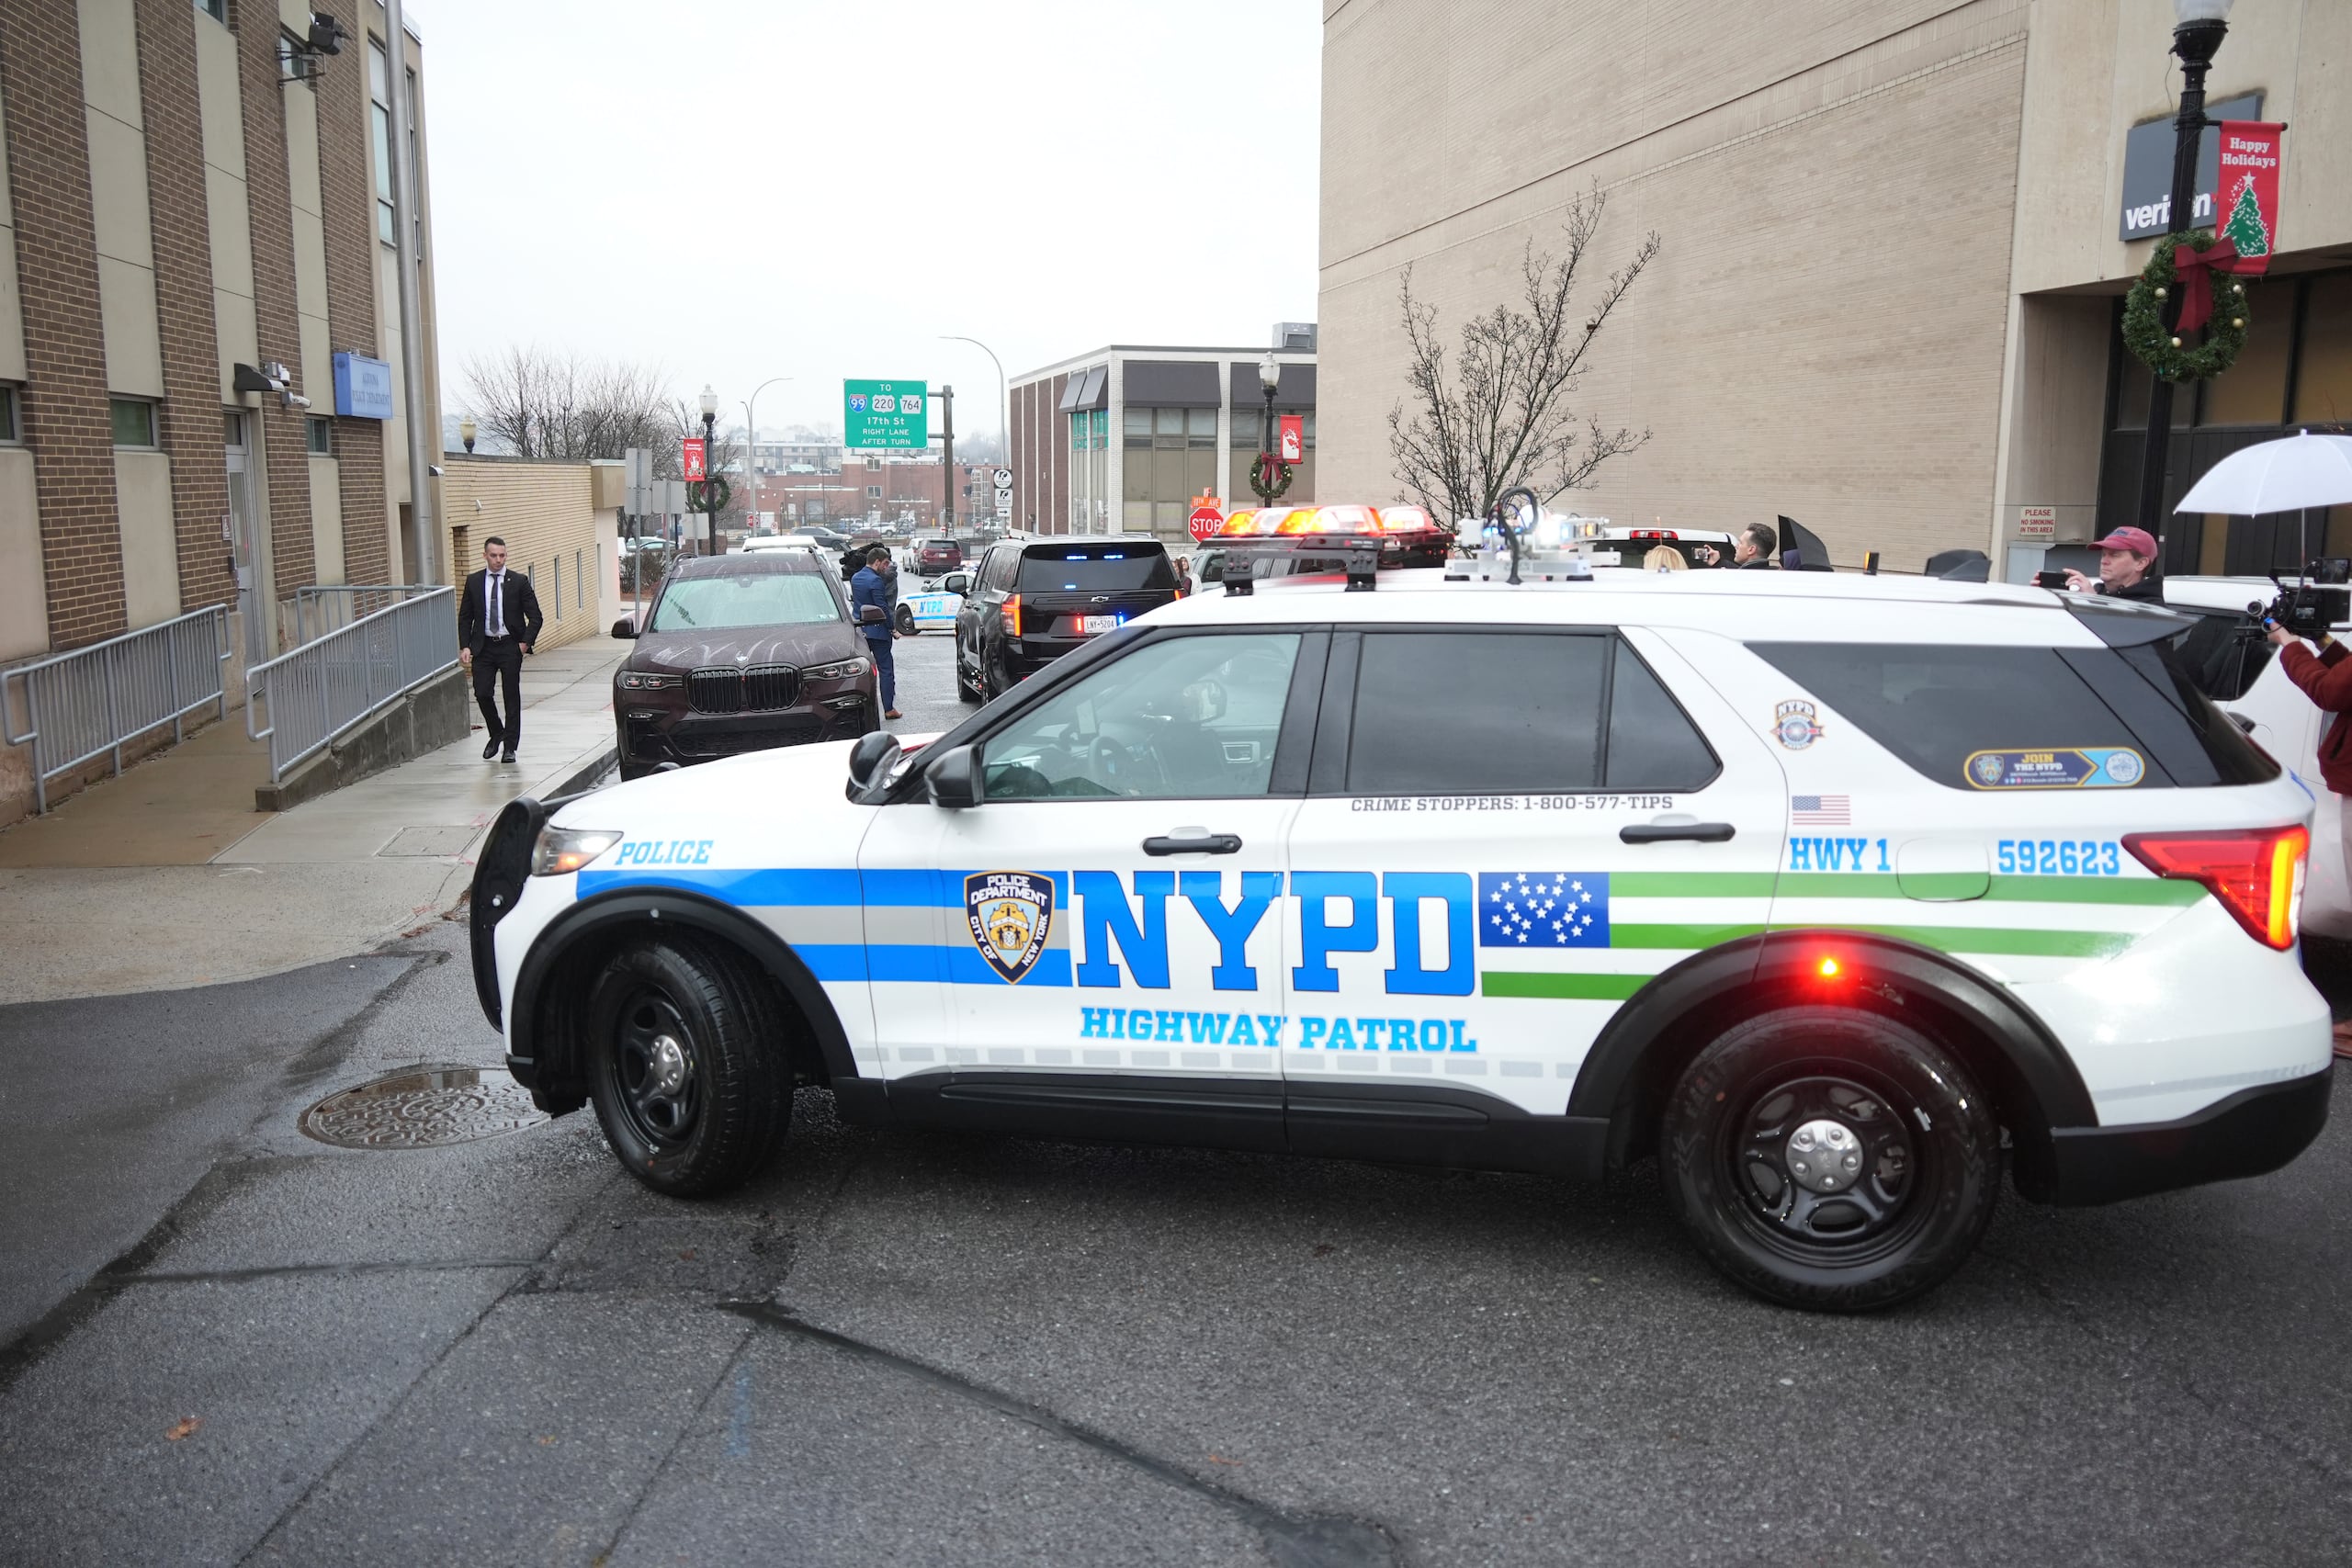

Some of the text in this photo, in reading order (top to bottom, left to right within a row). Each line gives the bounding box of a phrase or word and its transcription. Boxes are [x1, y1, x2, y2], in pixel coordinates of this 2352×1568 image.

[2230, 138, 2270, 153] Happy
[2222, 153, 2277, 169] Holidays
[2126, 193, 2211, 230] verin
[851, 399, 865, 409] 99
[874, 399, 893, 409] 220
[902, 400, 919, 410] 764
[867, 417, 889, 425] 17th
[1208, 498, 1221, 508] AVE
[1191, 518, 1222, 533] STOP
[920, 600, 944, 614] NYPD
[1778, 701, 1814, 717] NYPD
[2021, 753, 2054, 763] JOIN
[2014, 762, 2064, 772] THE NYPD
[1351, 795, 1674, 812] CRIME STOPPERS: 1-800-577-TIPS
[614, 840, 715, 866] POLICE
[1789, 838, 1892, 872] HWY 1
[1996, 840, 2121, 875] 592623
[987, 874, 1031, 888] POLICE
[970, 885, 1047, 907] DEPARTMENT
[969, 915, 999, 961] CITY OF
[1021, 913, 1048, 967] NEW YORK
[1072, 870, 1476, 997] NYPD
[1080, 1006, 1478, 1054] HIGHWAY PATROL
